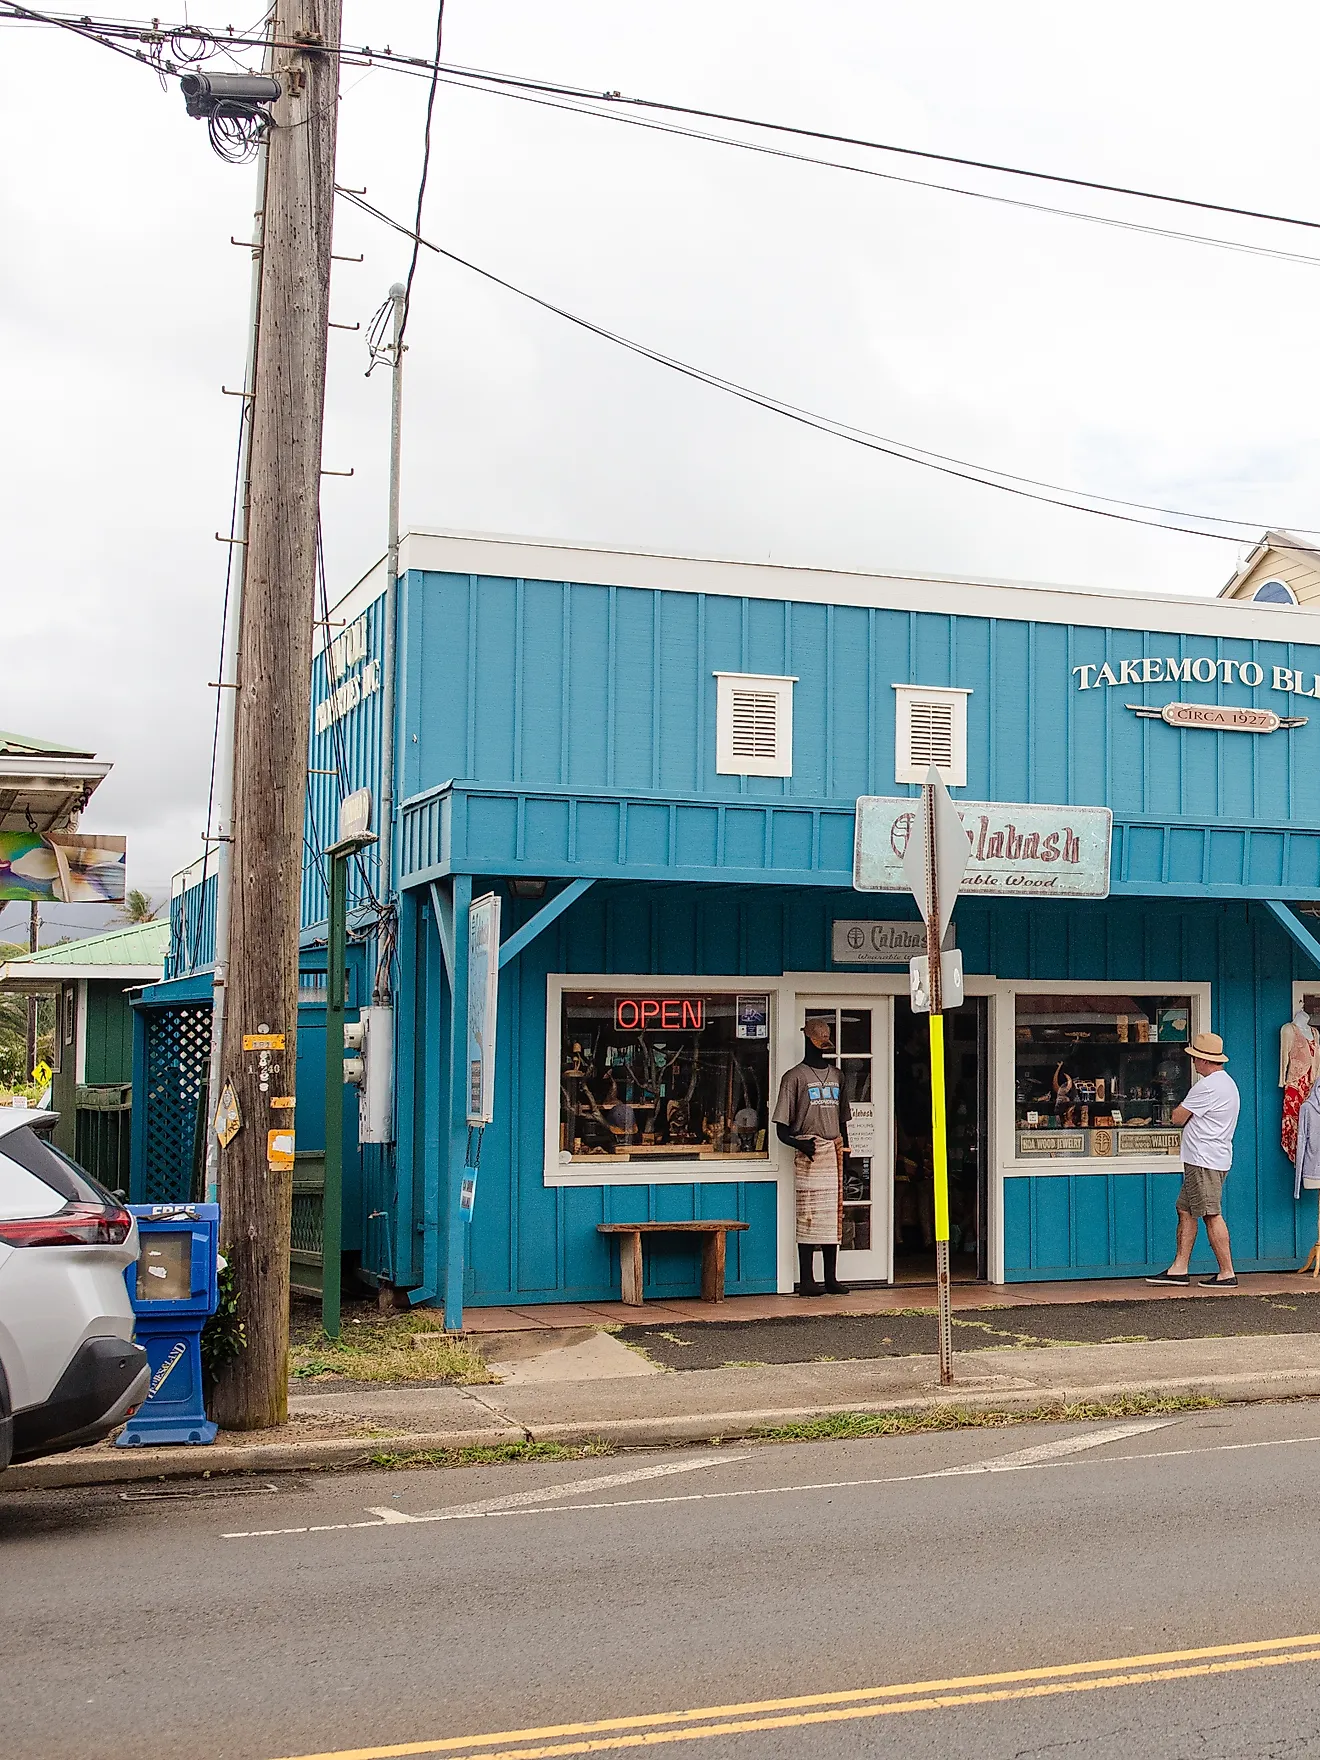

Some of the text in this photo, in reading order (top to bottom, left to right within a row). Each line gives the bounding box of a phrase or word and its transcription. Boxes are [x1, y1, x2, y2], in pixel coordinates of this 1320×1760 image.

[1072, 658, 1264, 691] TAKEMOTO
[1177, 709, 1267, 726] CIRCA 1927
[960, 873, 997, 884] able
[871, 925, 929, 952] Calabas
[618, 1000, 702, 1029] OPEN
[1036, 1138, 1056, 1149] WOOD
[1057, 1138, 1082, 1150] JEWELRY
[1151, 1133, 1180, 1148] WALLETS
